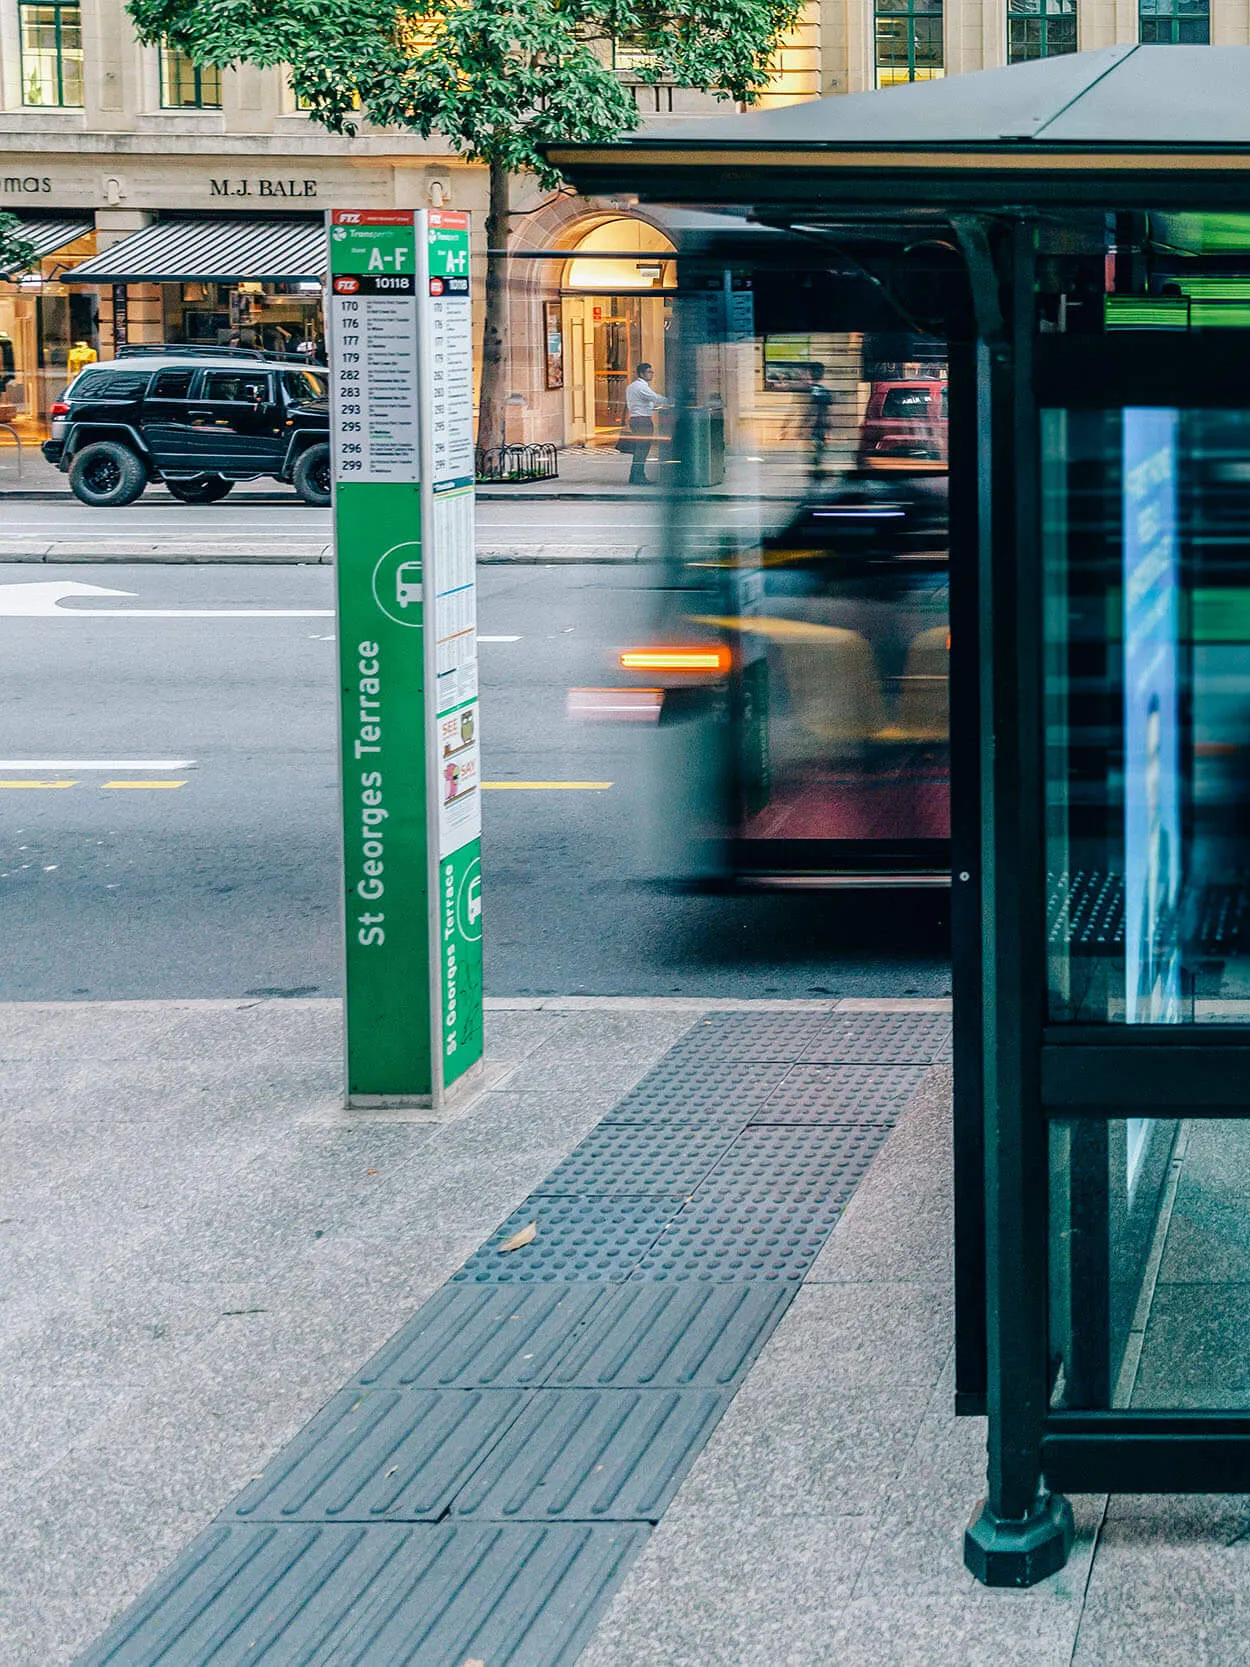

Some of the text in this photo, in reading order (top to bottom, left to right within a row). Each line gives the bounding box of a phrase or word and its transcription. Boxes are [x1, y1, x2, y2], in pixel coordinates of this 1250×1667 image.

[0, 177, 52, 192] mas
[209, 179, 317, 197] M.J. BALE
[368, 248, 408, 271] A-F
[375, 277, 410, 289] 10118
[341, 301, 359, 311] 170
[342, 318, 360, 329] 176
[343, 335, 360, 346] 177
[343, 352, 360, 363] 179
[340, 370, 360, 380] 282
[340, 387, 361, 398] 283
[341, 404, 361, 415] 293
[341, 421, 362, 432] 295
[341, 443, 362, 454] 296
[341, 460, 362, 471] 299
[354, 640, 389, 946] St Georges Terrace
